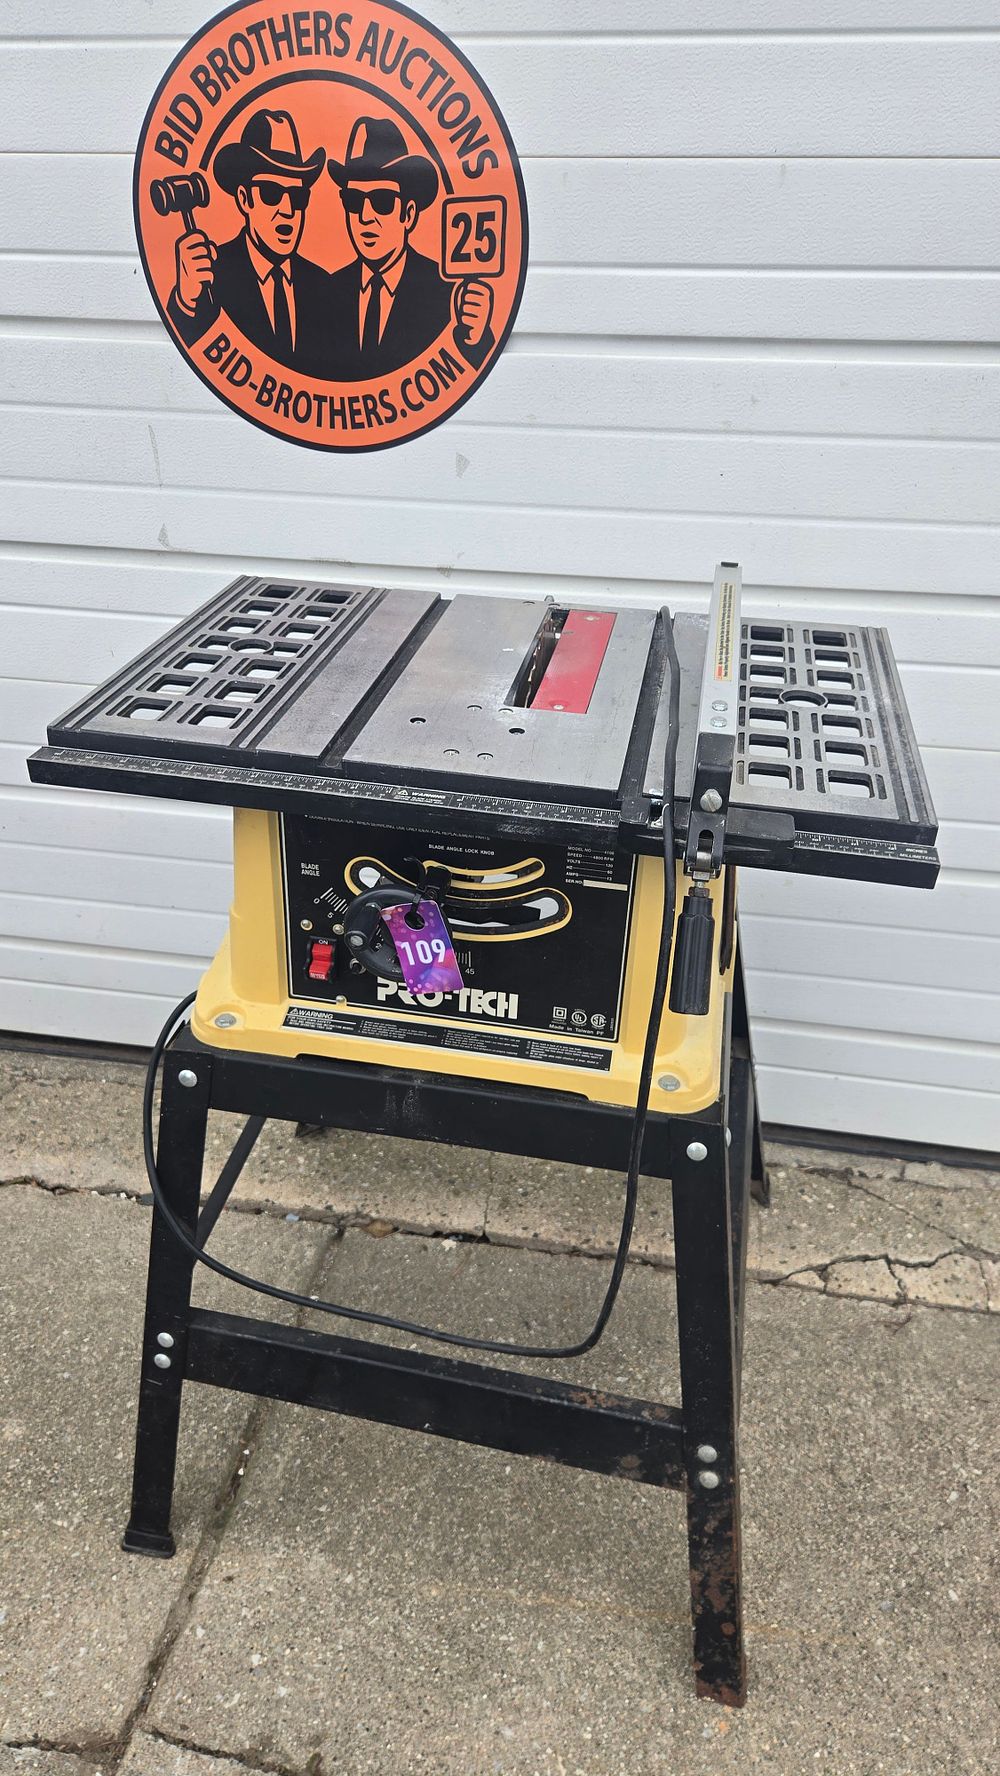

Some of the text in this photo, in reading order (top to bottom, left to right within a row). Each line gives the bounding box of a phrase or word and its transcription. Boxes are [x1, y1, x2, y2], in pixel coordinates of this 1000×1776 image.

[155, 10, 499, 179] BID BROTHERS AUCTIONS
[450, 211, 497, 263] 25
[202, 332, 466, 430] BID-BROTHERS.COM
[899, 853, 937, 861] MILLIMETERS
[301, 862, 320, 870] BLADE
[301, 869, 320, 877] ANGLE
[401, 939, 446, 966] 109
[465, 967, 475, 975] 45
[299, 1009, 334, 1019] WARNING
